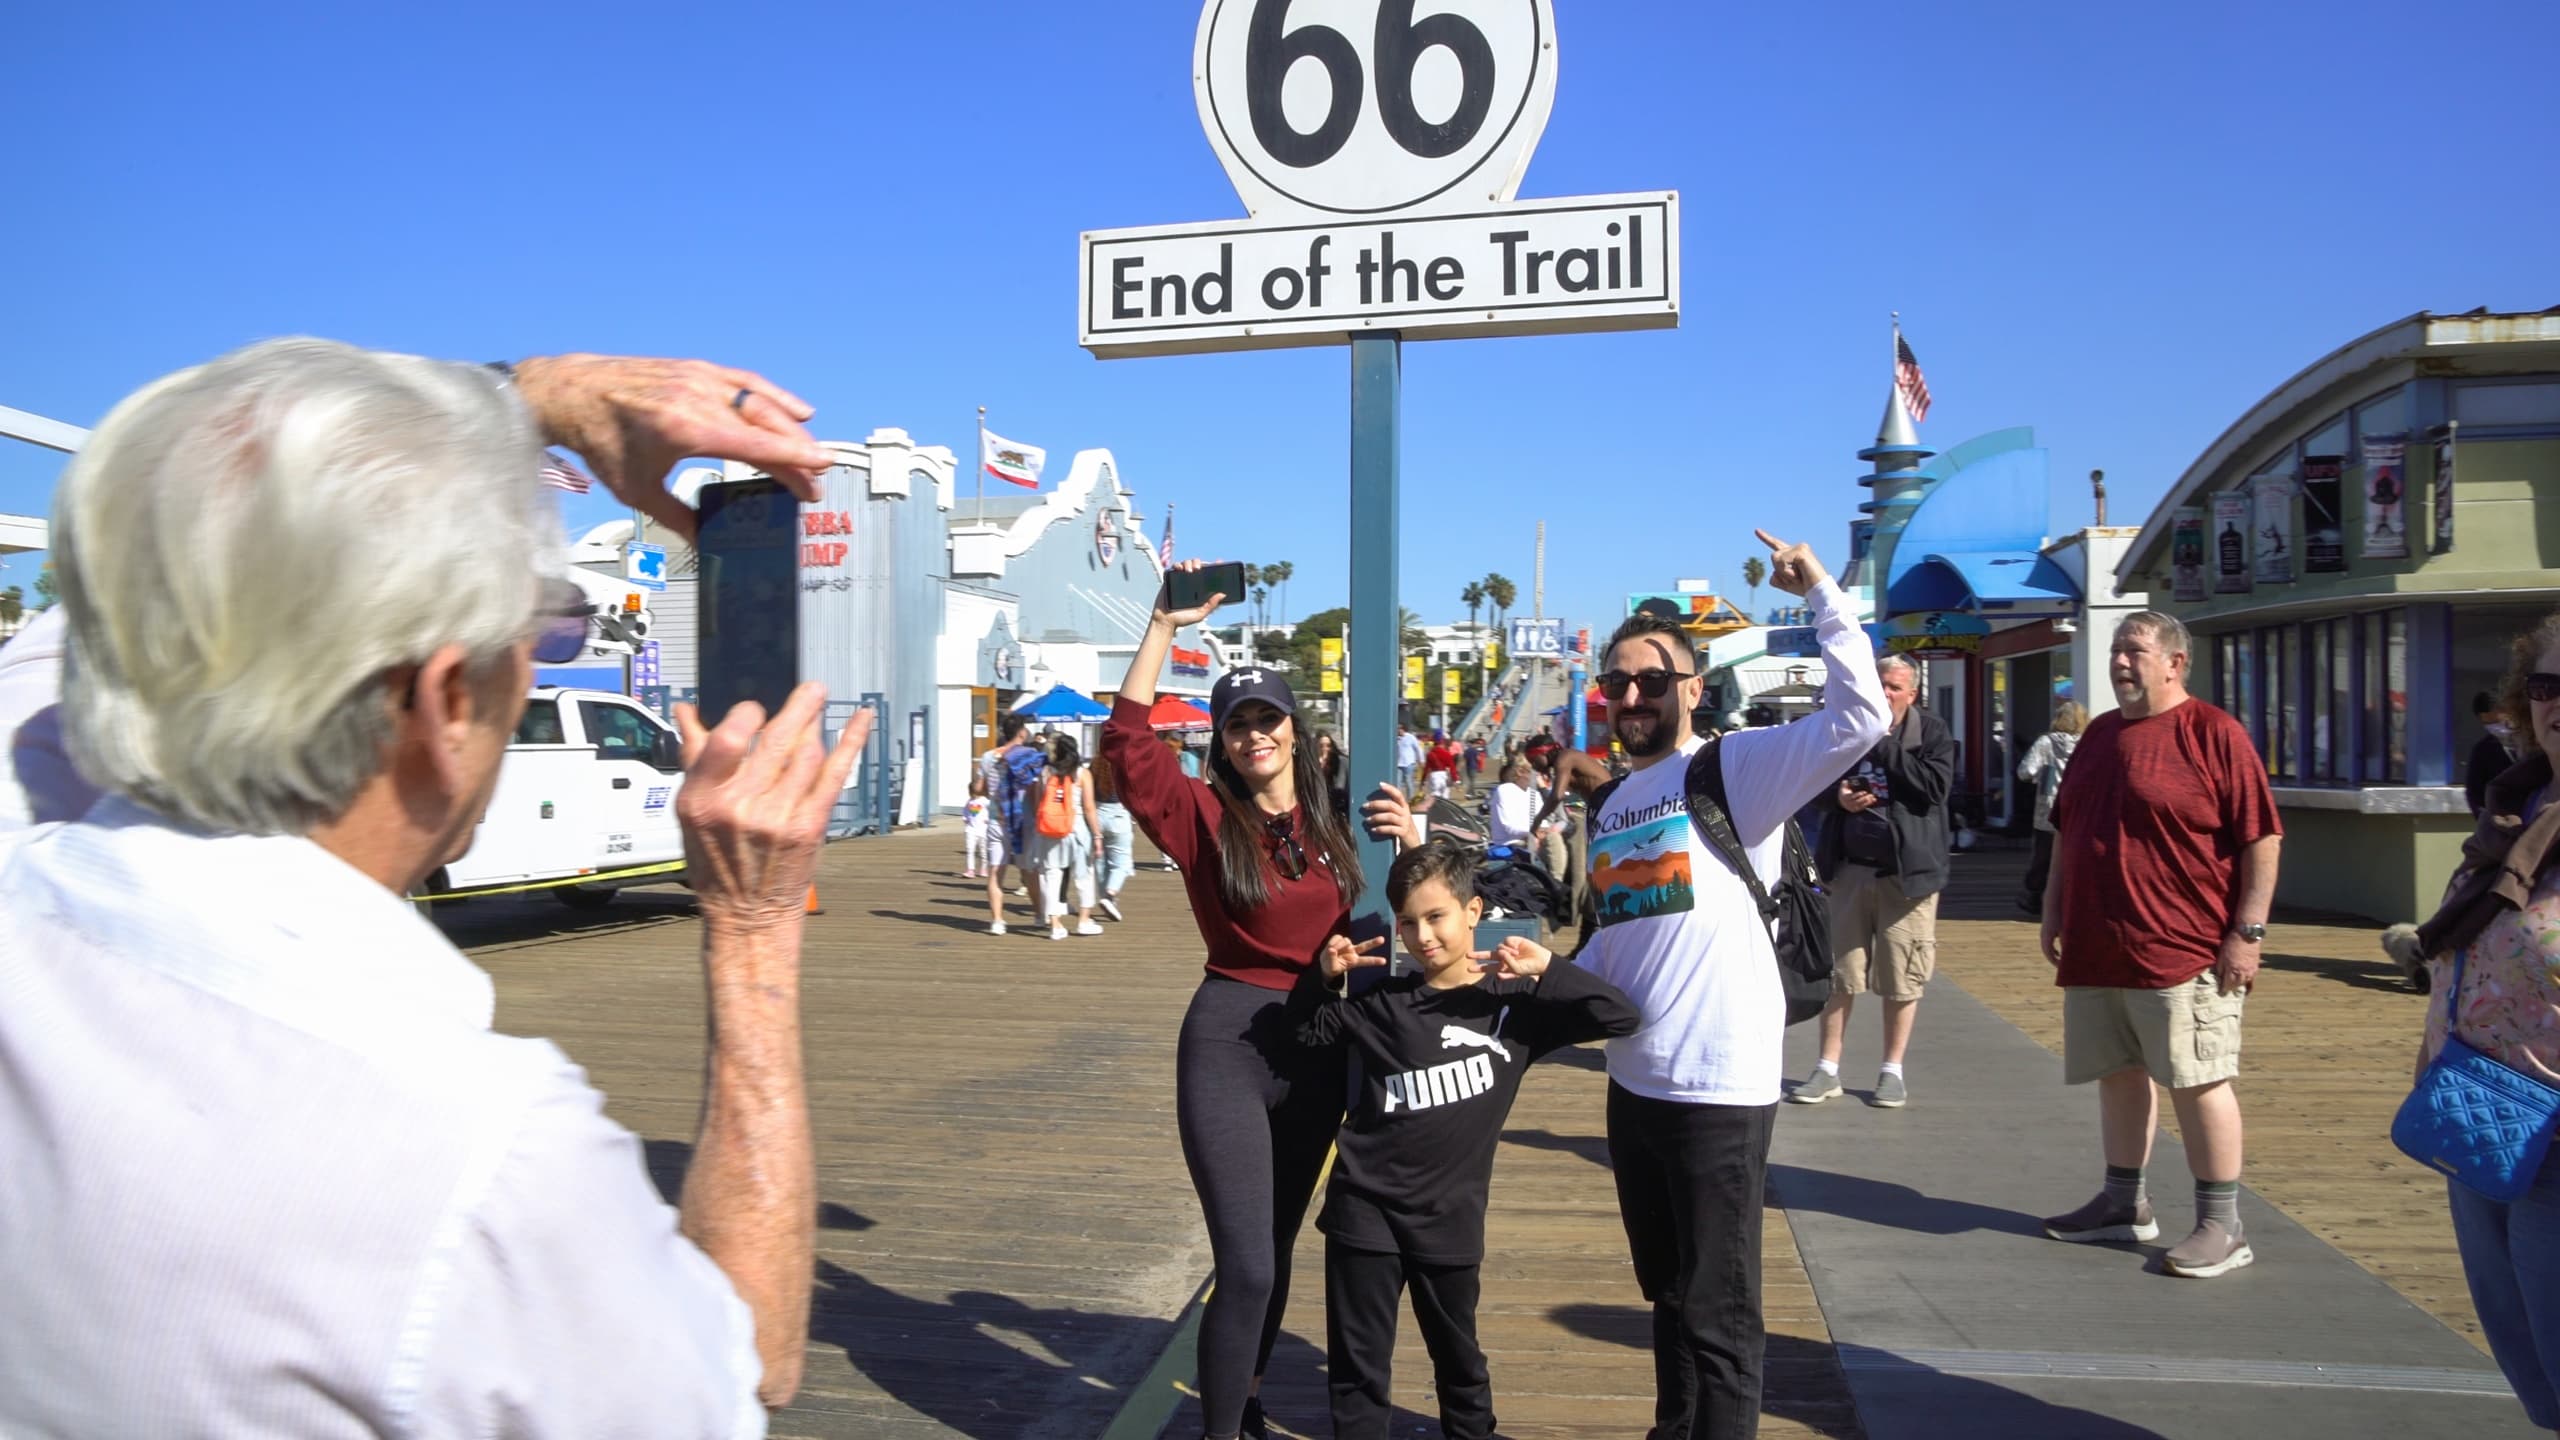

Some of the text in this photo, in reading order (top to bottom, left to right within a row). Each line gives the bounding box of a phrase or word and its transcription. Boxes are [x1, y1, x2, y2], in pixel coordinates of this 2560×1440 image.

[1246, 0, 1496, 168] 66
[1112, 215, 1643, 320] End of the Trail
[800, 511, 853, 536] BBA
[1601, 792, 1688, 834] Columbia
[1384, 1053, 1494, 1113] PUMA
